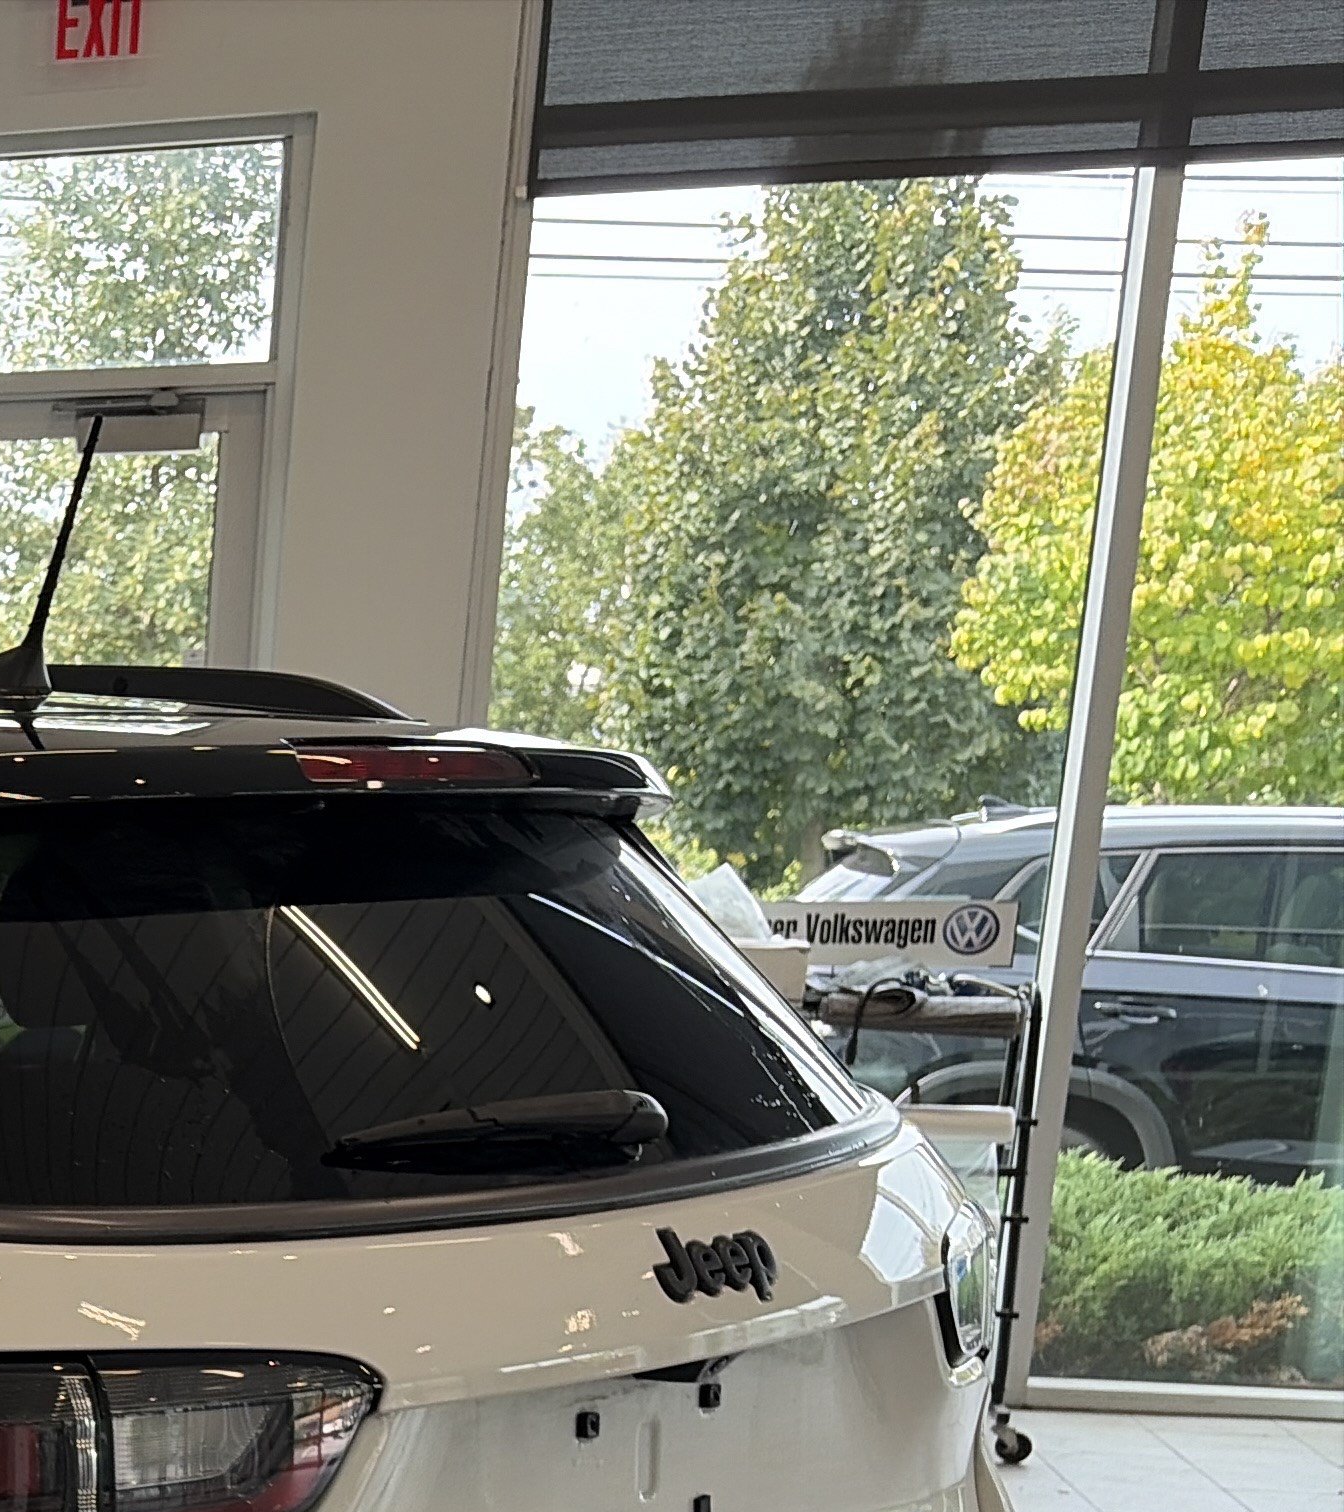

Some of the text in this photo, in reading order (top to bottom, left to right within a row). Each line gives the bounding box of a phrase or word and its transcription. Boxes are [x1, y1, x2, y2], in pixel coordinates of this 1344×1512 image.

[55, 0, 143, 60] EXIT
[806, 911, 937, 949] Volkswagen
[653, 1226, 777, 1303] Jeep
